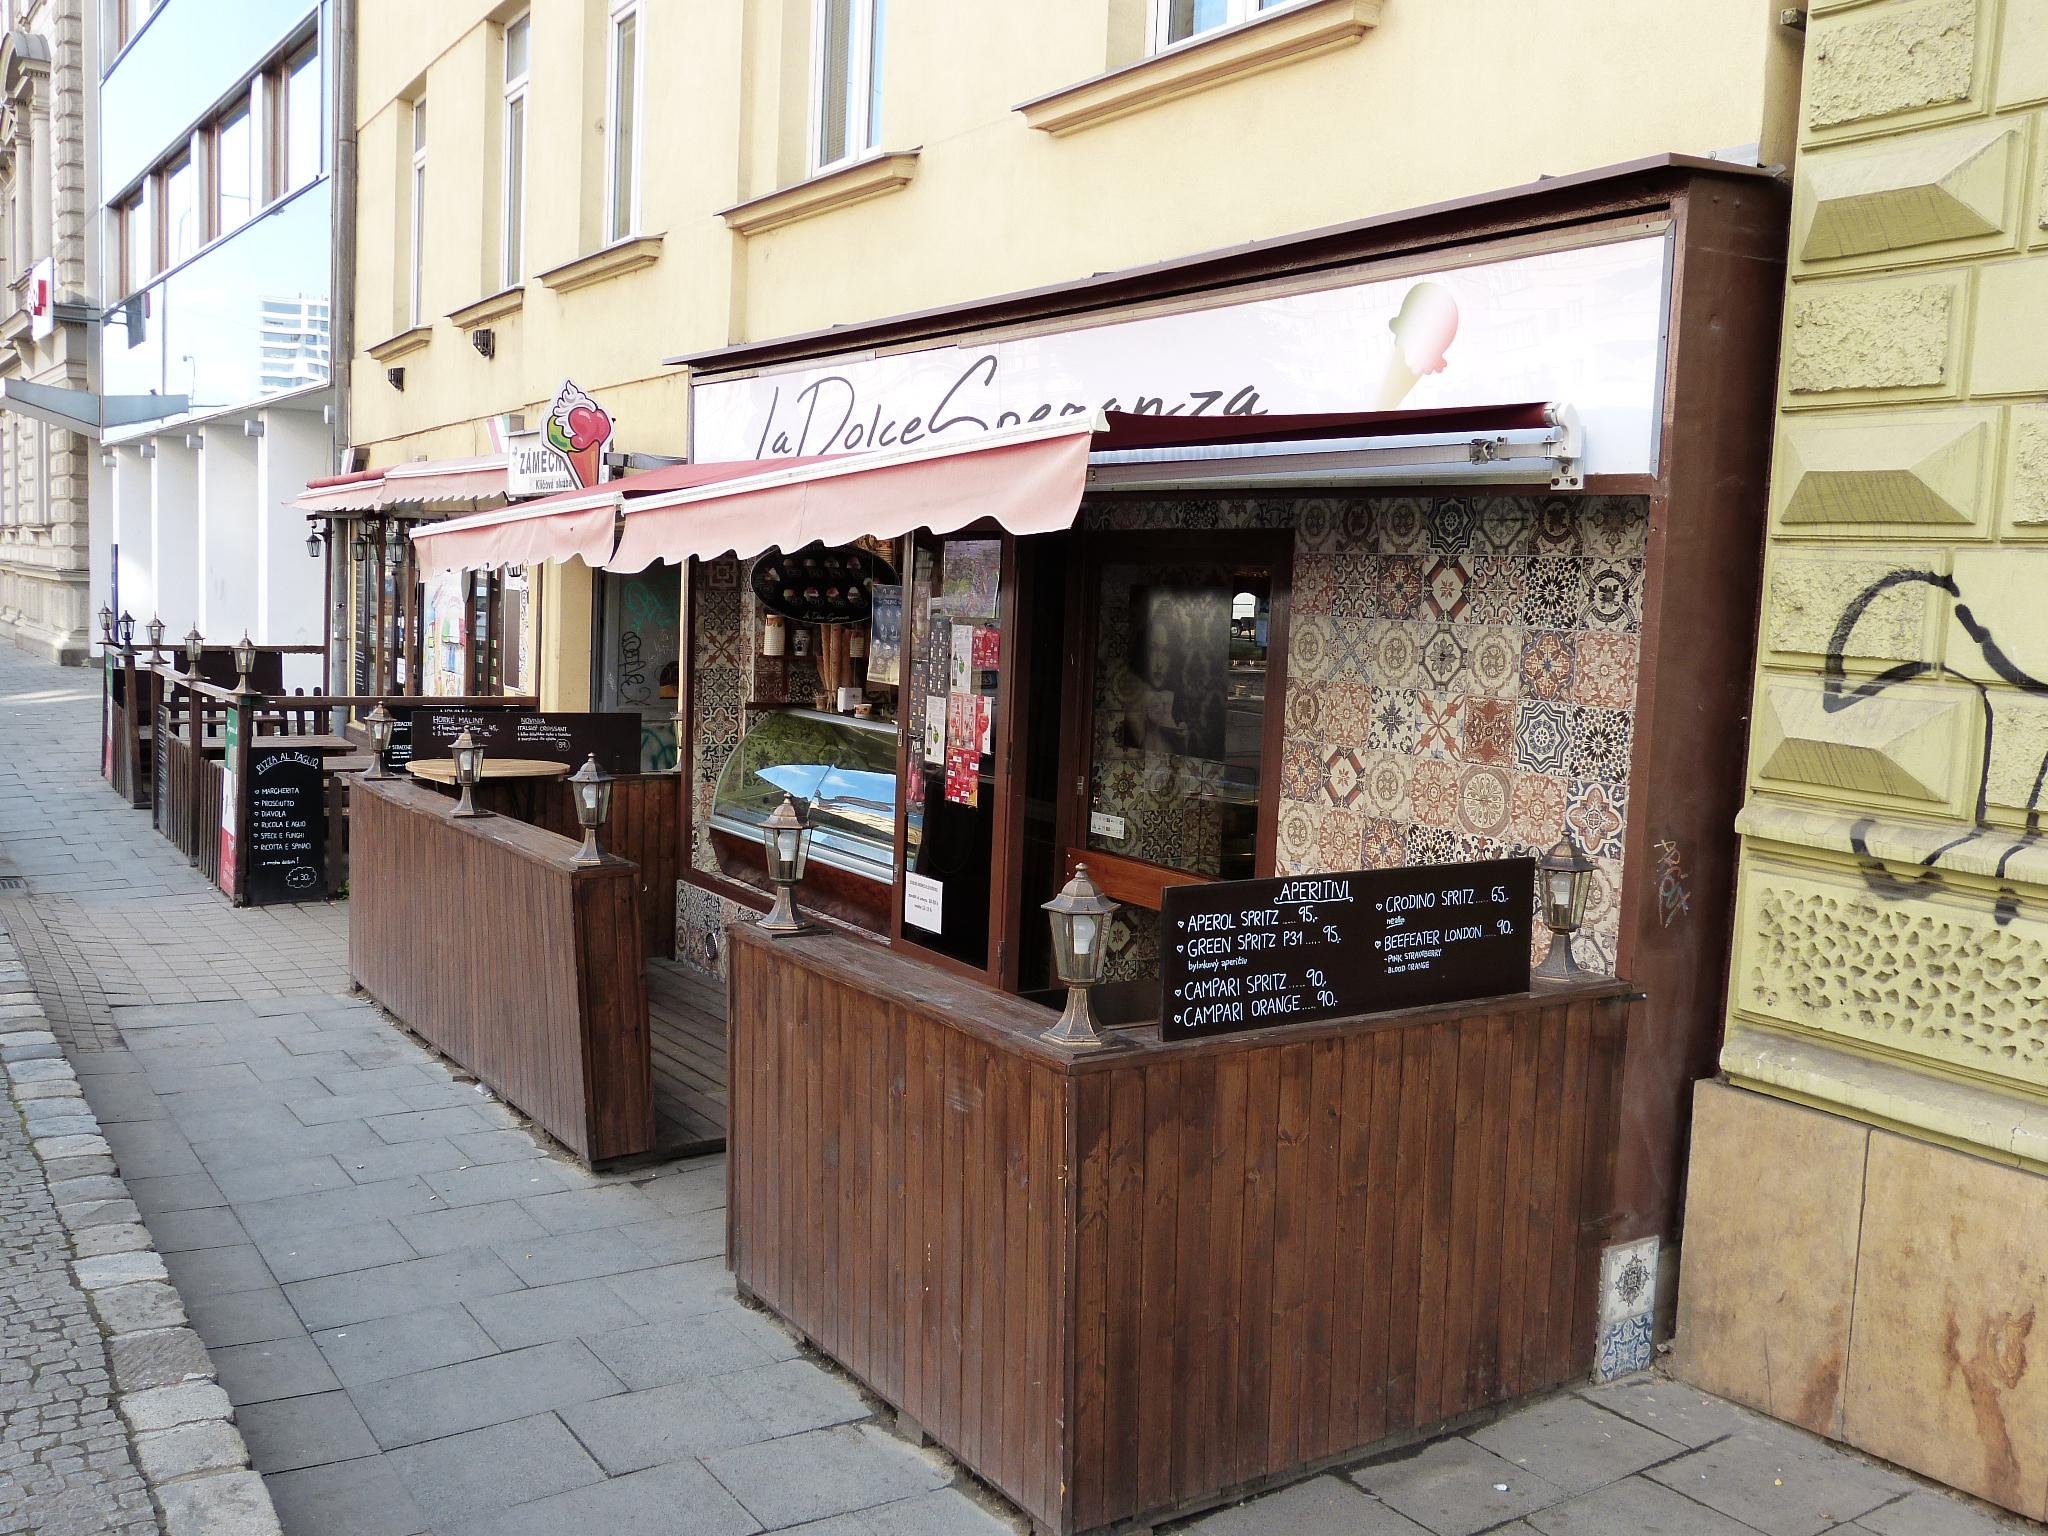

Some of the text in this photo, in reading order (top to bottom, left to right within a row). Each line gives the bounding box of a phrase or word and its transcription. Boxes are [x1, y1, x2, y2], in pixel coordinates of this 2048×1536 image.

[255, 755, 278, 772] PIZZA
[280, 752, 290, 761] AL
[261, 787, 300, 795] MARGHERITA
[261, 799, 295, 807] PROSCIUTTO
[261, 810, 287, 818] DIAVOLA
[261, 820, 307, 829] RUCOLA E AGLIO
[260, 832, 277, 840] SPECK
[260, 843, 283, 851] RICOTTA
[284, 843, 289, 851] E
[1279, 879, 1350, 901] APERITIVI
[1385, 892, 1436, 913] CRODINO
[1441, 888, 1475, 906] SPRITZ
[1187, 913, 1237, 932] APEROL
[1240, 909, 1279, 927] SPRITZ
[1187, 936, 1231, 957] GREEN
[1237, 933, 1276, 951] SPRITZ
[1283, 931, 1303, 947] P31
[1384, 929, 1440, 951] BEEFEATER
[1444, 924, 1482, 942] LONDON
[1407, 960, 1430, 971] ORANGE
[1184, 977, 1241, 1000] CAMPARI
[1246, 973, 1287, 994] SPRITZ
[1183, 1002, 1243, 1027] CAMPARI
[1251, 994, 1301, 1017] ORANGE
